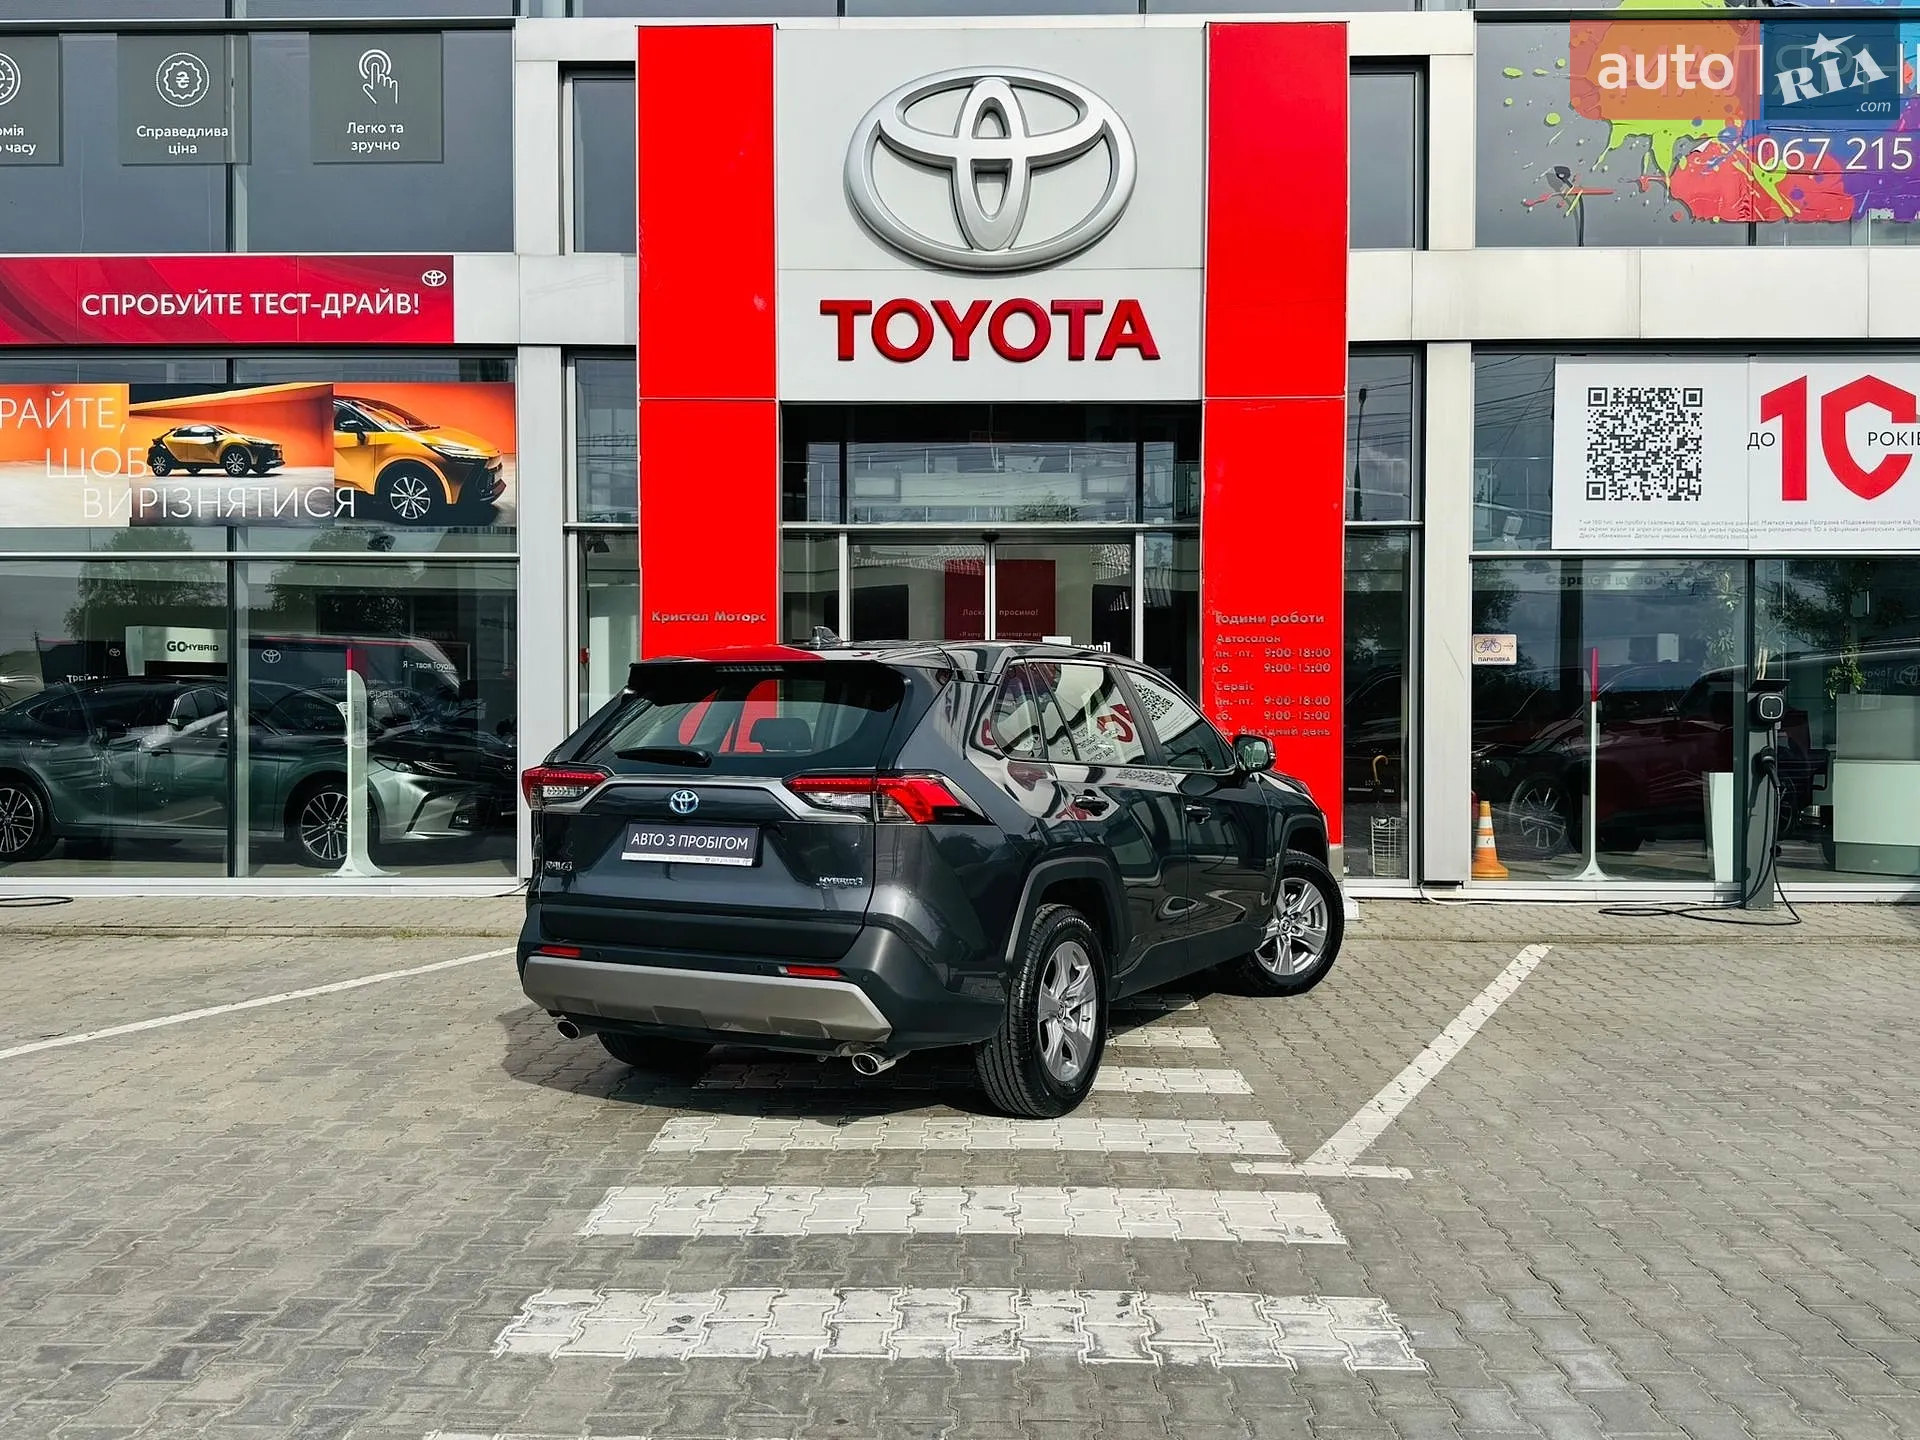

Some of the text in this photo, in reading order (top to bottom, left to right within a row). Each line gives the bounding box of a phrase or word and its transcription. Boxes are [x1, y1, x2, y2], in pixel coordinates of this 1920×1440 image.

[136, 125, 229, 140] Справедлива
[346, 122, 404, 135] Легко та
[5, 143, 37, 156] часу
[168, 142, 198, 155] ціна
[351, 140, 401, 154] зручно
[1756, 137, 1913, 171] 067 215
[81, 287, 420, 318] СПРОБУЙТЕ ТЕСТ-ДРАЙВ!
[819, 297, 1161, 363] TOYOTA
[1747, 432, 1776, 450] ДО
[45, 447, 148, 481] ЩОБ
[82, 486, 356, 519] ВИРІЗНЯТИСЯ
[651, 611, 767, 624] Кристал Моторс
[1215, 611, 1325, 626] Години роботи
[1216, 633, 1281, 643] Автосалон
[1215, 681, 1255, 693] Сервіс
[630, 832, 749, 851] АВТО З ПРОБІГОМ
